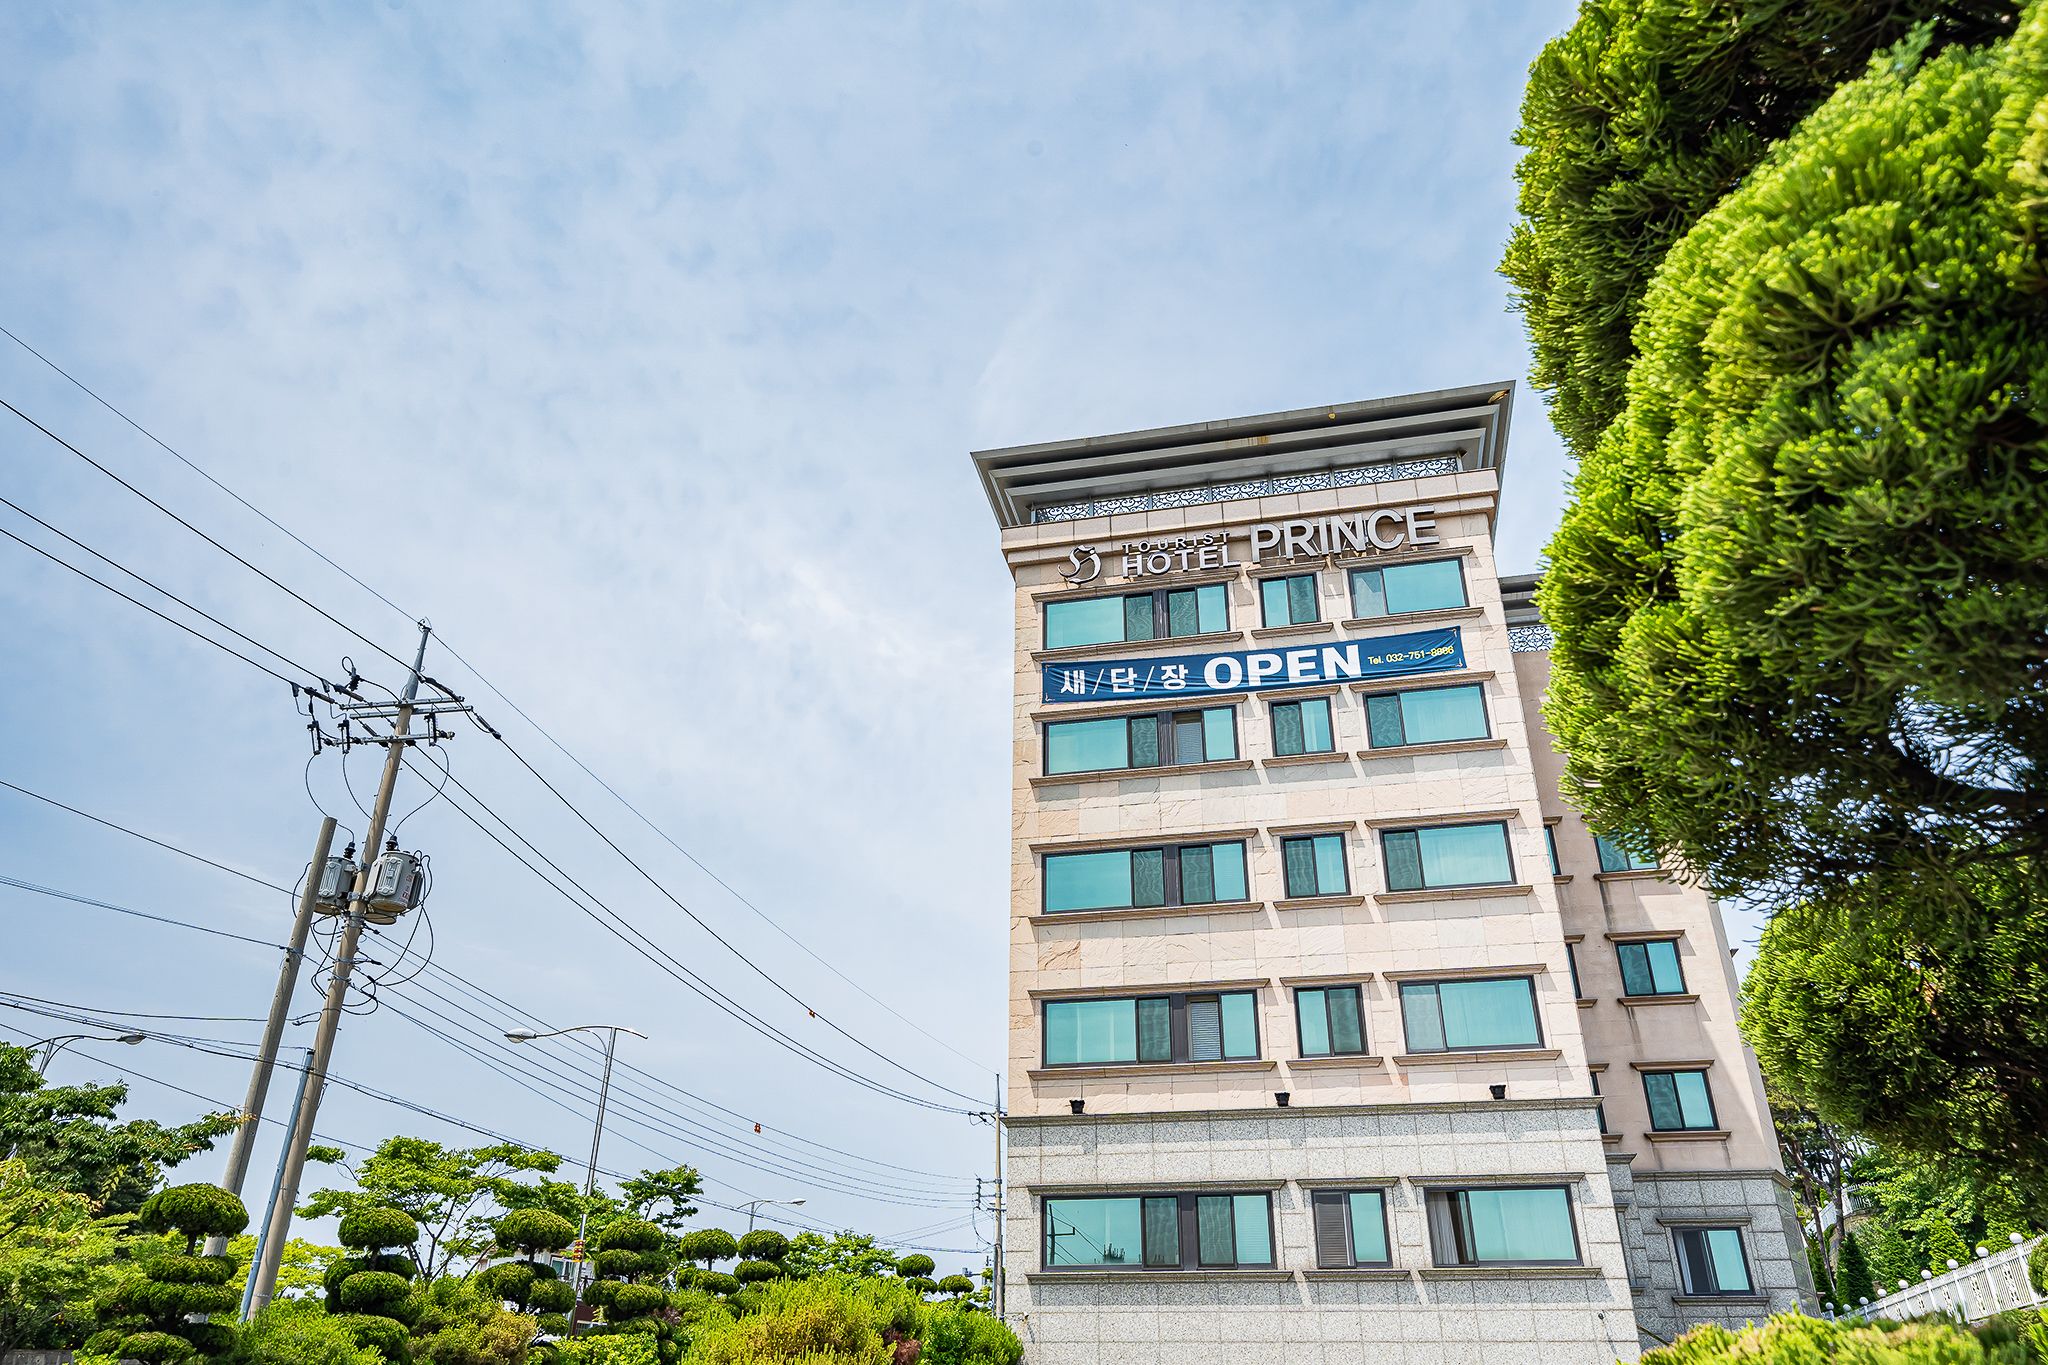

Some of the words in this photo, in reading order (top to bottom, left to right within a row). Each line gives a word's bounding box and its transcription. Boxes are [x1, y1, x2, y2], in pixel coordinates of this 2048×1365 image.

[1121, 545, 1241, 579] HOTEL
[1250, 505, 1440, 564] PRINCE
[1122, 531, 1230, 554] TOURIST
[1203, 644, 1362, 690] OPEN
[1367, 655, 1384, 665] Tel.
